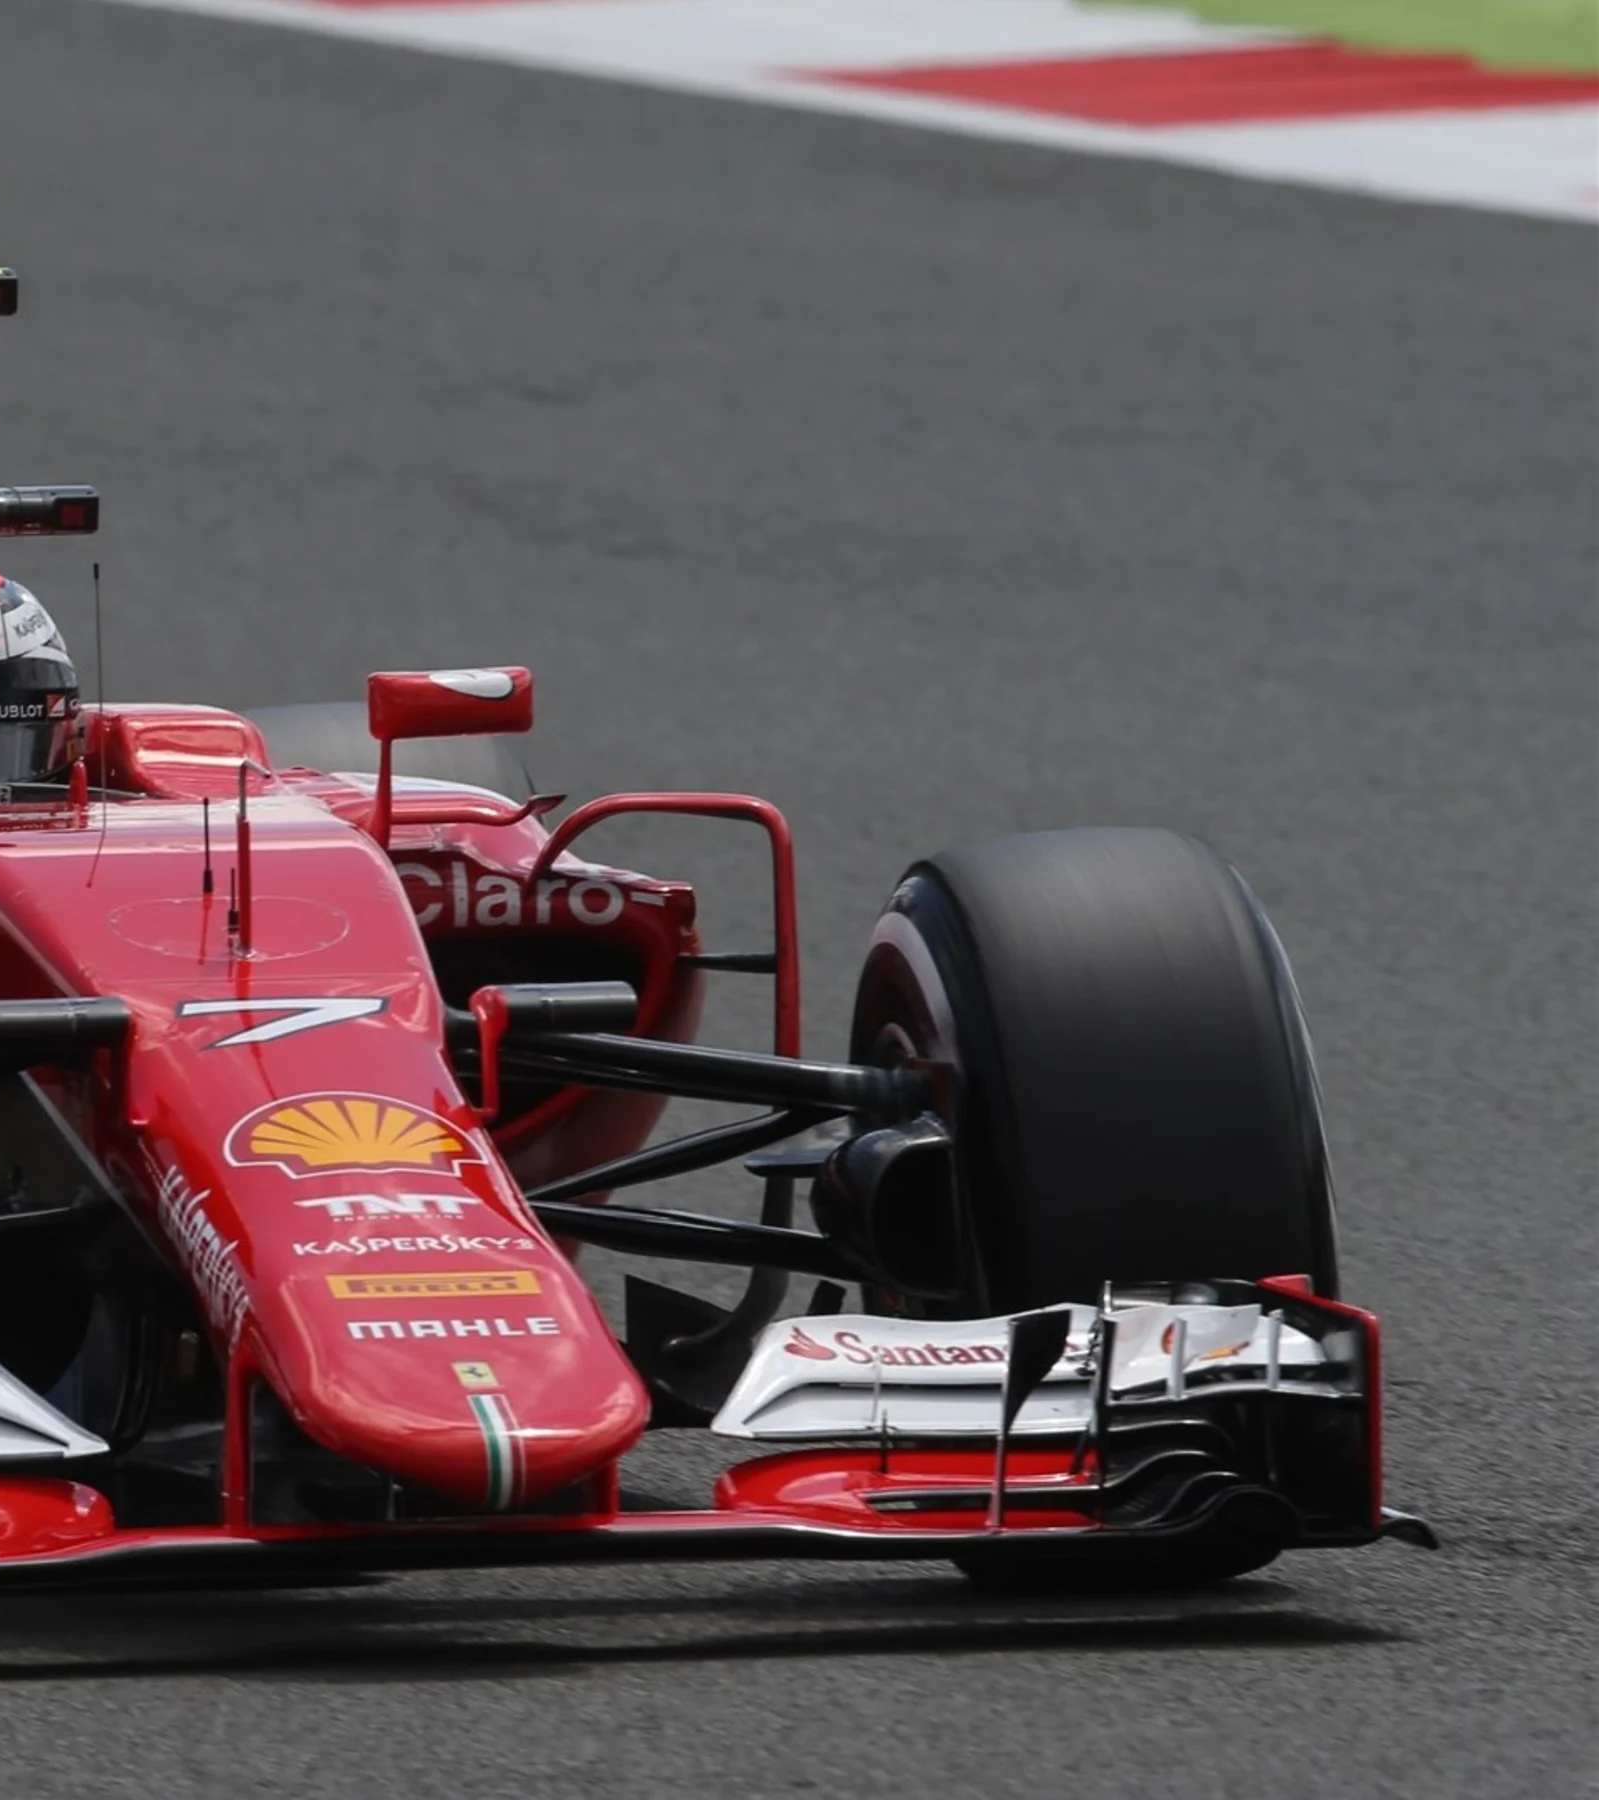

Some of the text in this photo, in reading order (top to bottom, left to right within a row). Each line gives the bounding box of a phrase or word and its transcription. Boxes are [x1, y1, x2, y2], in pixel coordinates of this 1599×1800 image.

[396, 861, 625, 929] Claro
[177, 997, 390, 1051] 7
[293, 1193, 486, 1217] TNT
[292, 1234, 512, 1256] KASPERSKY
[344, 1275, 520, 1294] PIRELLI
[346, 1316, 561, 1341] MAHLE
[834, 1330, 1080, 1368] Santan
